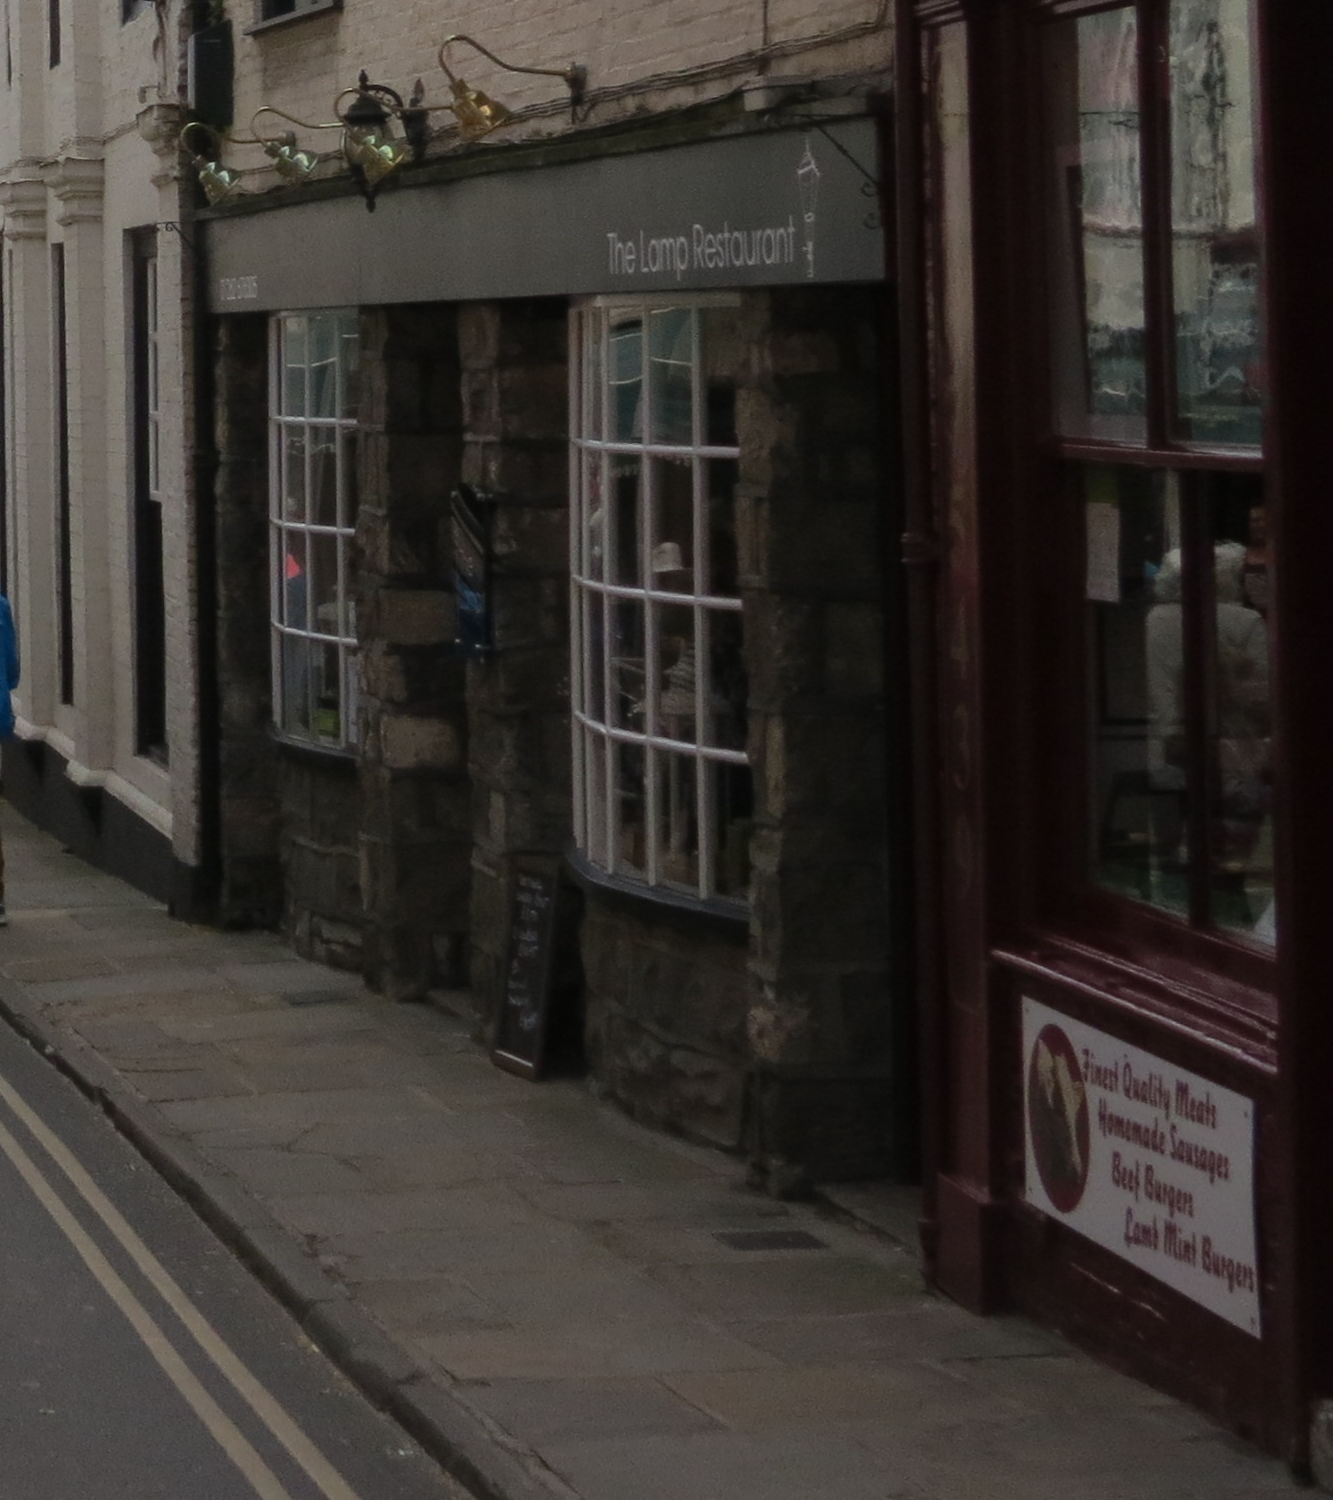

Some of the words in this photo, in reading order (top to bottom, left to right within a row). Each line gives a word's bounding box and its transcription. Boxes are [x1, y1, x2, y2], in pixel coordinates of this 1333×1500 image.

[607, 231, 636, 276] The
[639, 226, 688, 280] Lamp
[691, 217, 795, 267] Restaurant
[1081, 1048, 1120, 1093] Finest
[1123, 1058, 1171, 1122] Quality
[1175, 1080, 1217, 1129] Meats
[1099, 1098, 1166, 1156] Homemade
[1170, 1124, 1229, 1184] Sausages
[1112, 1151, 1141, 1199] Beef
[1144, 1164, 1195, 1218] Burgers
[1163, 1219, 1197, 1266] Mint
[1201, 1235, 1257, 1294] Burgers
